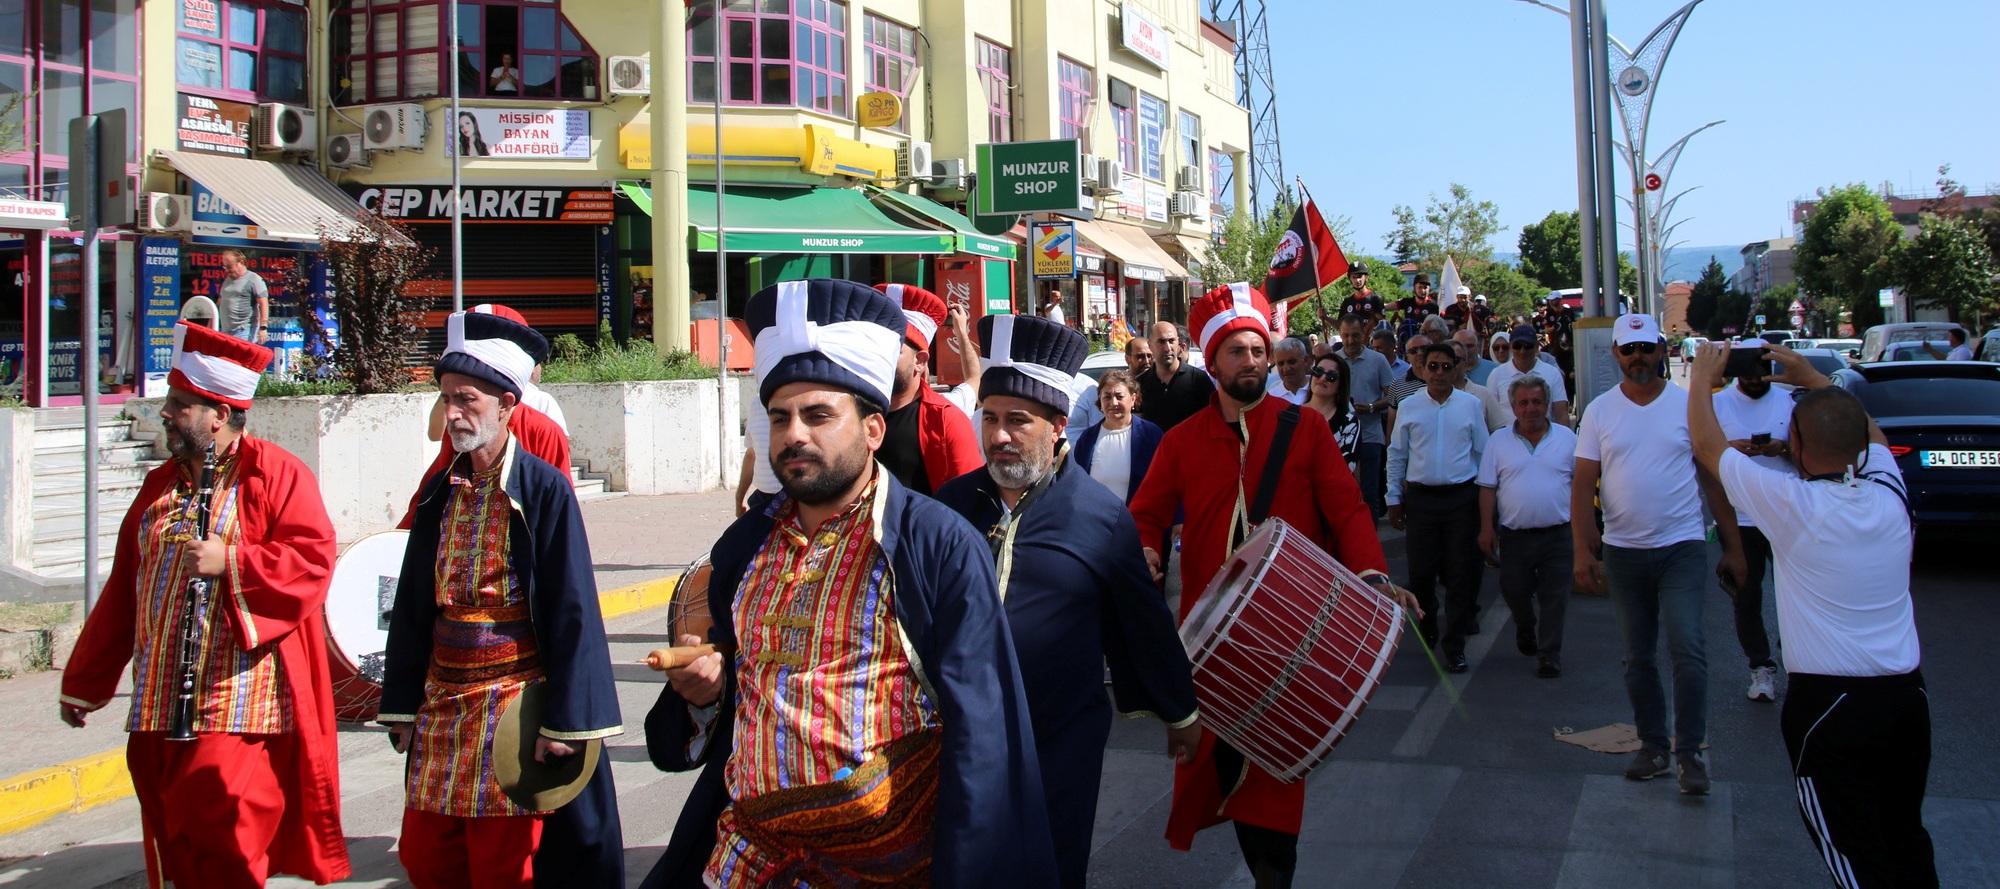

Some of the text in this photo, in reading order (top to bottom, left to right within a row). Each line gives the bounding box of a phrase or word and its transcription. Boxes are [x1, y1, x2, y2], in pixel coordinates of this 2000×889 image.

[503, 128, 549, 139] BAYAN
[494, 142, 559, 155] KUAFÖRÜ
[1002, 161, 1069, 177] MUNZUR
[1014, 180, 1058, 195] SHOP
[359, 187, 562, 217] CEP MARKET
[802, 238, 864, 247] MUNZUR SHOP
[146, 246, 178, 256] BALKAN
[152, 275, 172, 285] SIFIR
[191, 279, 211, 295] 12
[1929, 453, 1946, 465] 34
[1951, 453, 1976, 465] DCR
